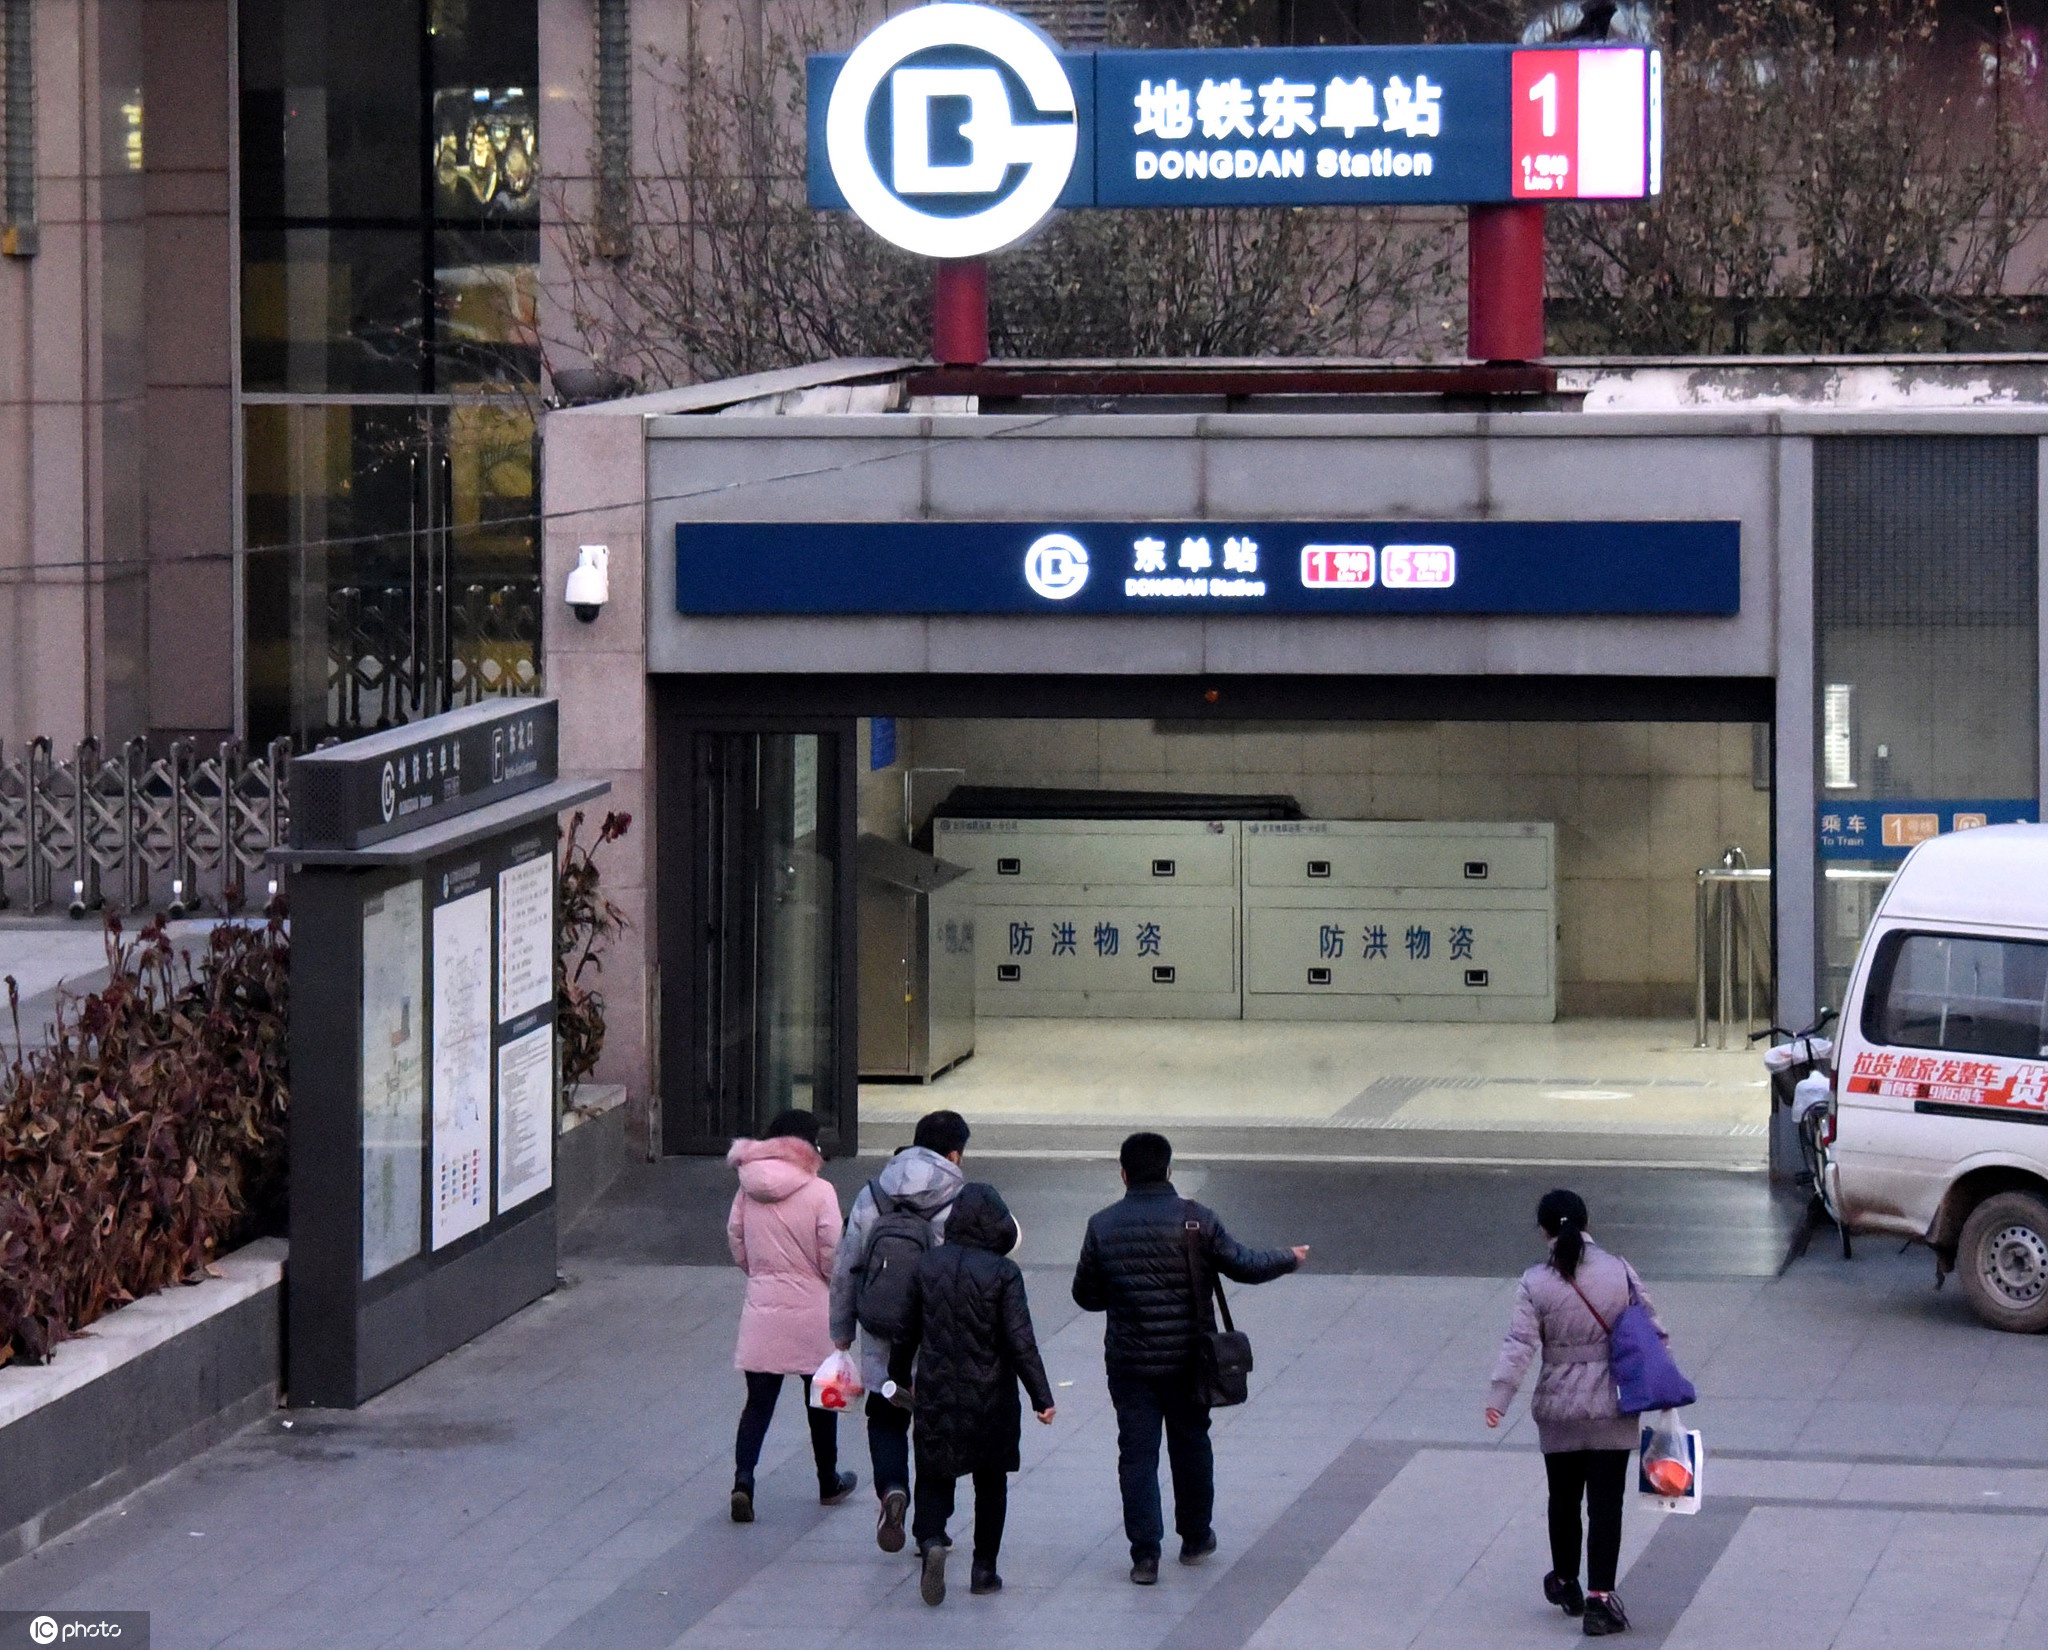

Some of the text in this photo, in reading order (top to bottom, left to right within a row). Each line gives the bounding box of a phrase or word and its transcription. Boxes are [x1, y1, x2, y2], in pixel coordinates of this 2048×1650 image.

[1133, 75, 1442, 140] 地铁东单站
[1529, 72, 1557, 137] 1
[1135, 147, 1432, 179] DONGDAN Station
[1133, 537, 1258, 573] 东单站
[1821, 814, 1867, 834] 乘车
[1822, 836, 1864, 847] To Train
[1008, 922, 1163, 958] 防洪物资
[1319, 924, 1477, 961] 防洪物资
[2007, 1064, 2048, 1107] 货
